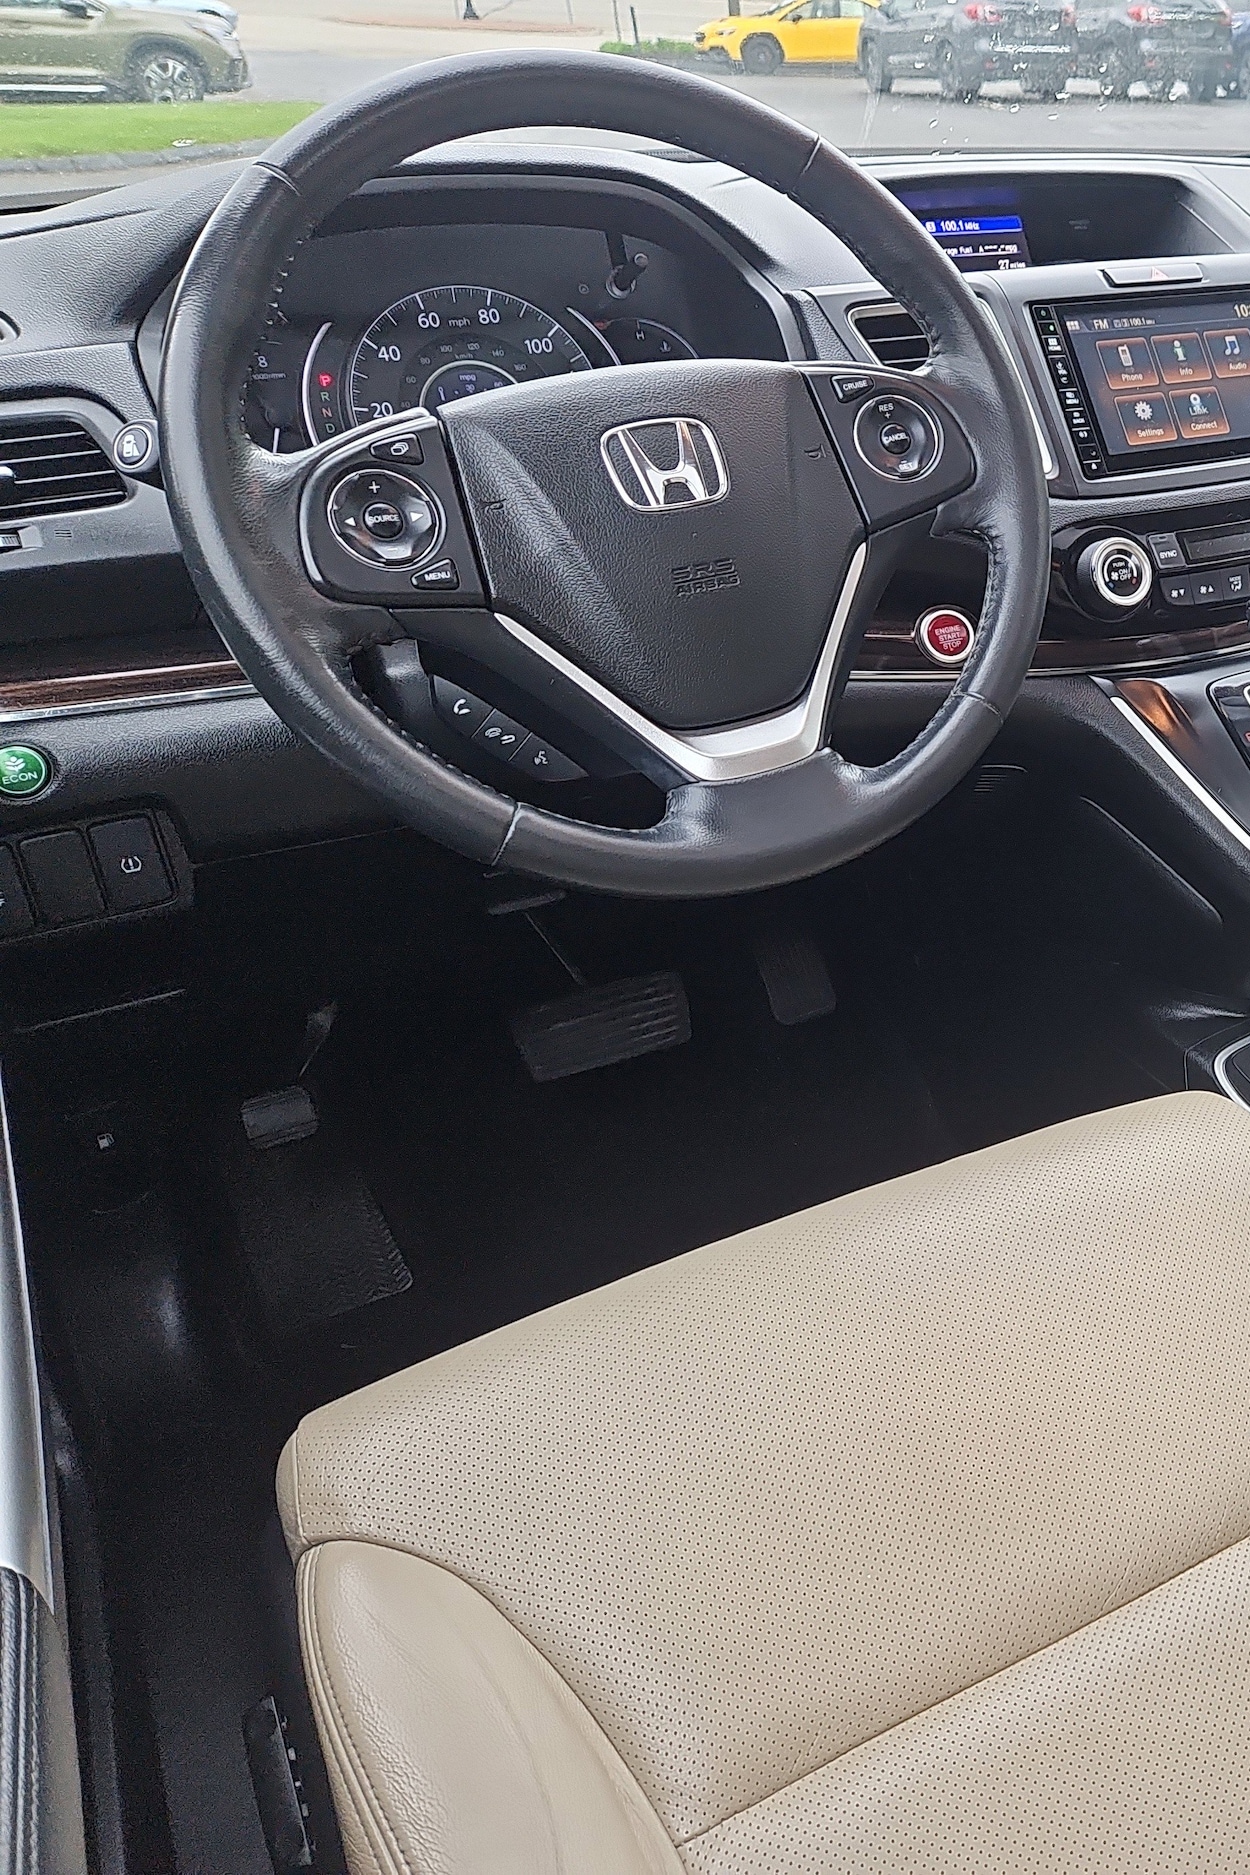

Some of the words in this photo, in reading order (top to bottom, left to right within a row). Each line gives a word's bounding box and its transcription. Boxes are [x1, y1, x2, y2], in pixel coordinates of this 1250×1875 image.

[940, 220, 964, 232] 100.1
[998, 259, 1010, 270] 27
[417, 311, 440, 329] 60
[478, 308, 500, 325] 80
[448, 316, 471, 329] mph
[1093, 318, 1109, 331] FM
[1129, 317, 1146, 327] 100.1
[467, 341, 480, 351] 120
[523, 336, 553, 354] 100
[377, 345, 401, 362] 40
[492, 349, 505, 358] 140
[258, 355, 268, 368] 8
[1229, 361, 1247, 371] Audio
[514, 363, 527, 372] 160
[1179, 367, 1193, 377] Info
[319, 374, 331, 387] P
[1121, 372, 1143, 382] Phone
[843, 380, 868, 391] CRUISE
[320, 391, 330, 402] R
[322, 407, 332, 418] N
[370, 401, 394, 418] 20
[878, 402, 894, 412] RES
[325, 423, 336, 434] D
[1191, 421, 1218, 431] Connect
[883, 432, 909, 444] CANCEL
[1137, 427, 1164, 438] Settings
[899, 461, 913, 470] SET
[367, 514, 400, 524] SOURCE
[1159, 550, 1178, 560] SYNC
[425, 571, 451, 581] MENU
[1120, 573, 1132, 581] OFF
[934, 624, 961, 636] ENGINE
[938, 631, 961, 642] START
[942, 640, 962, 651] STOP
[2, 771, 39, 785] ECON
